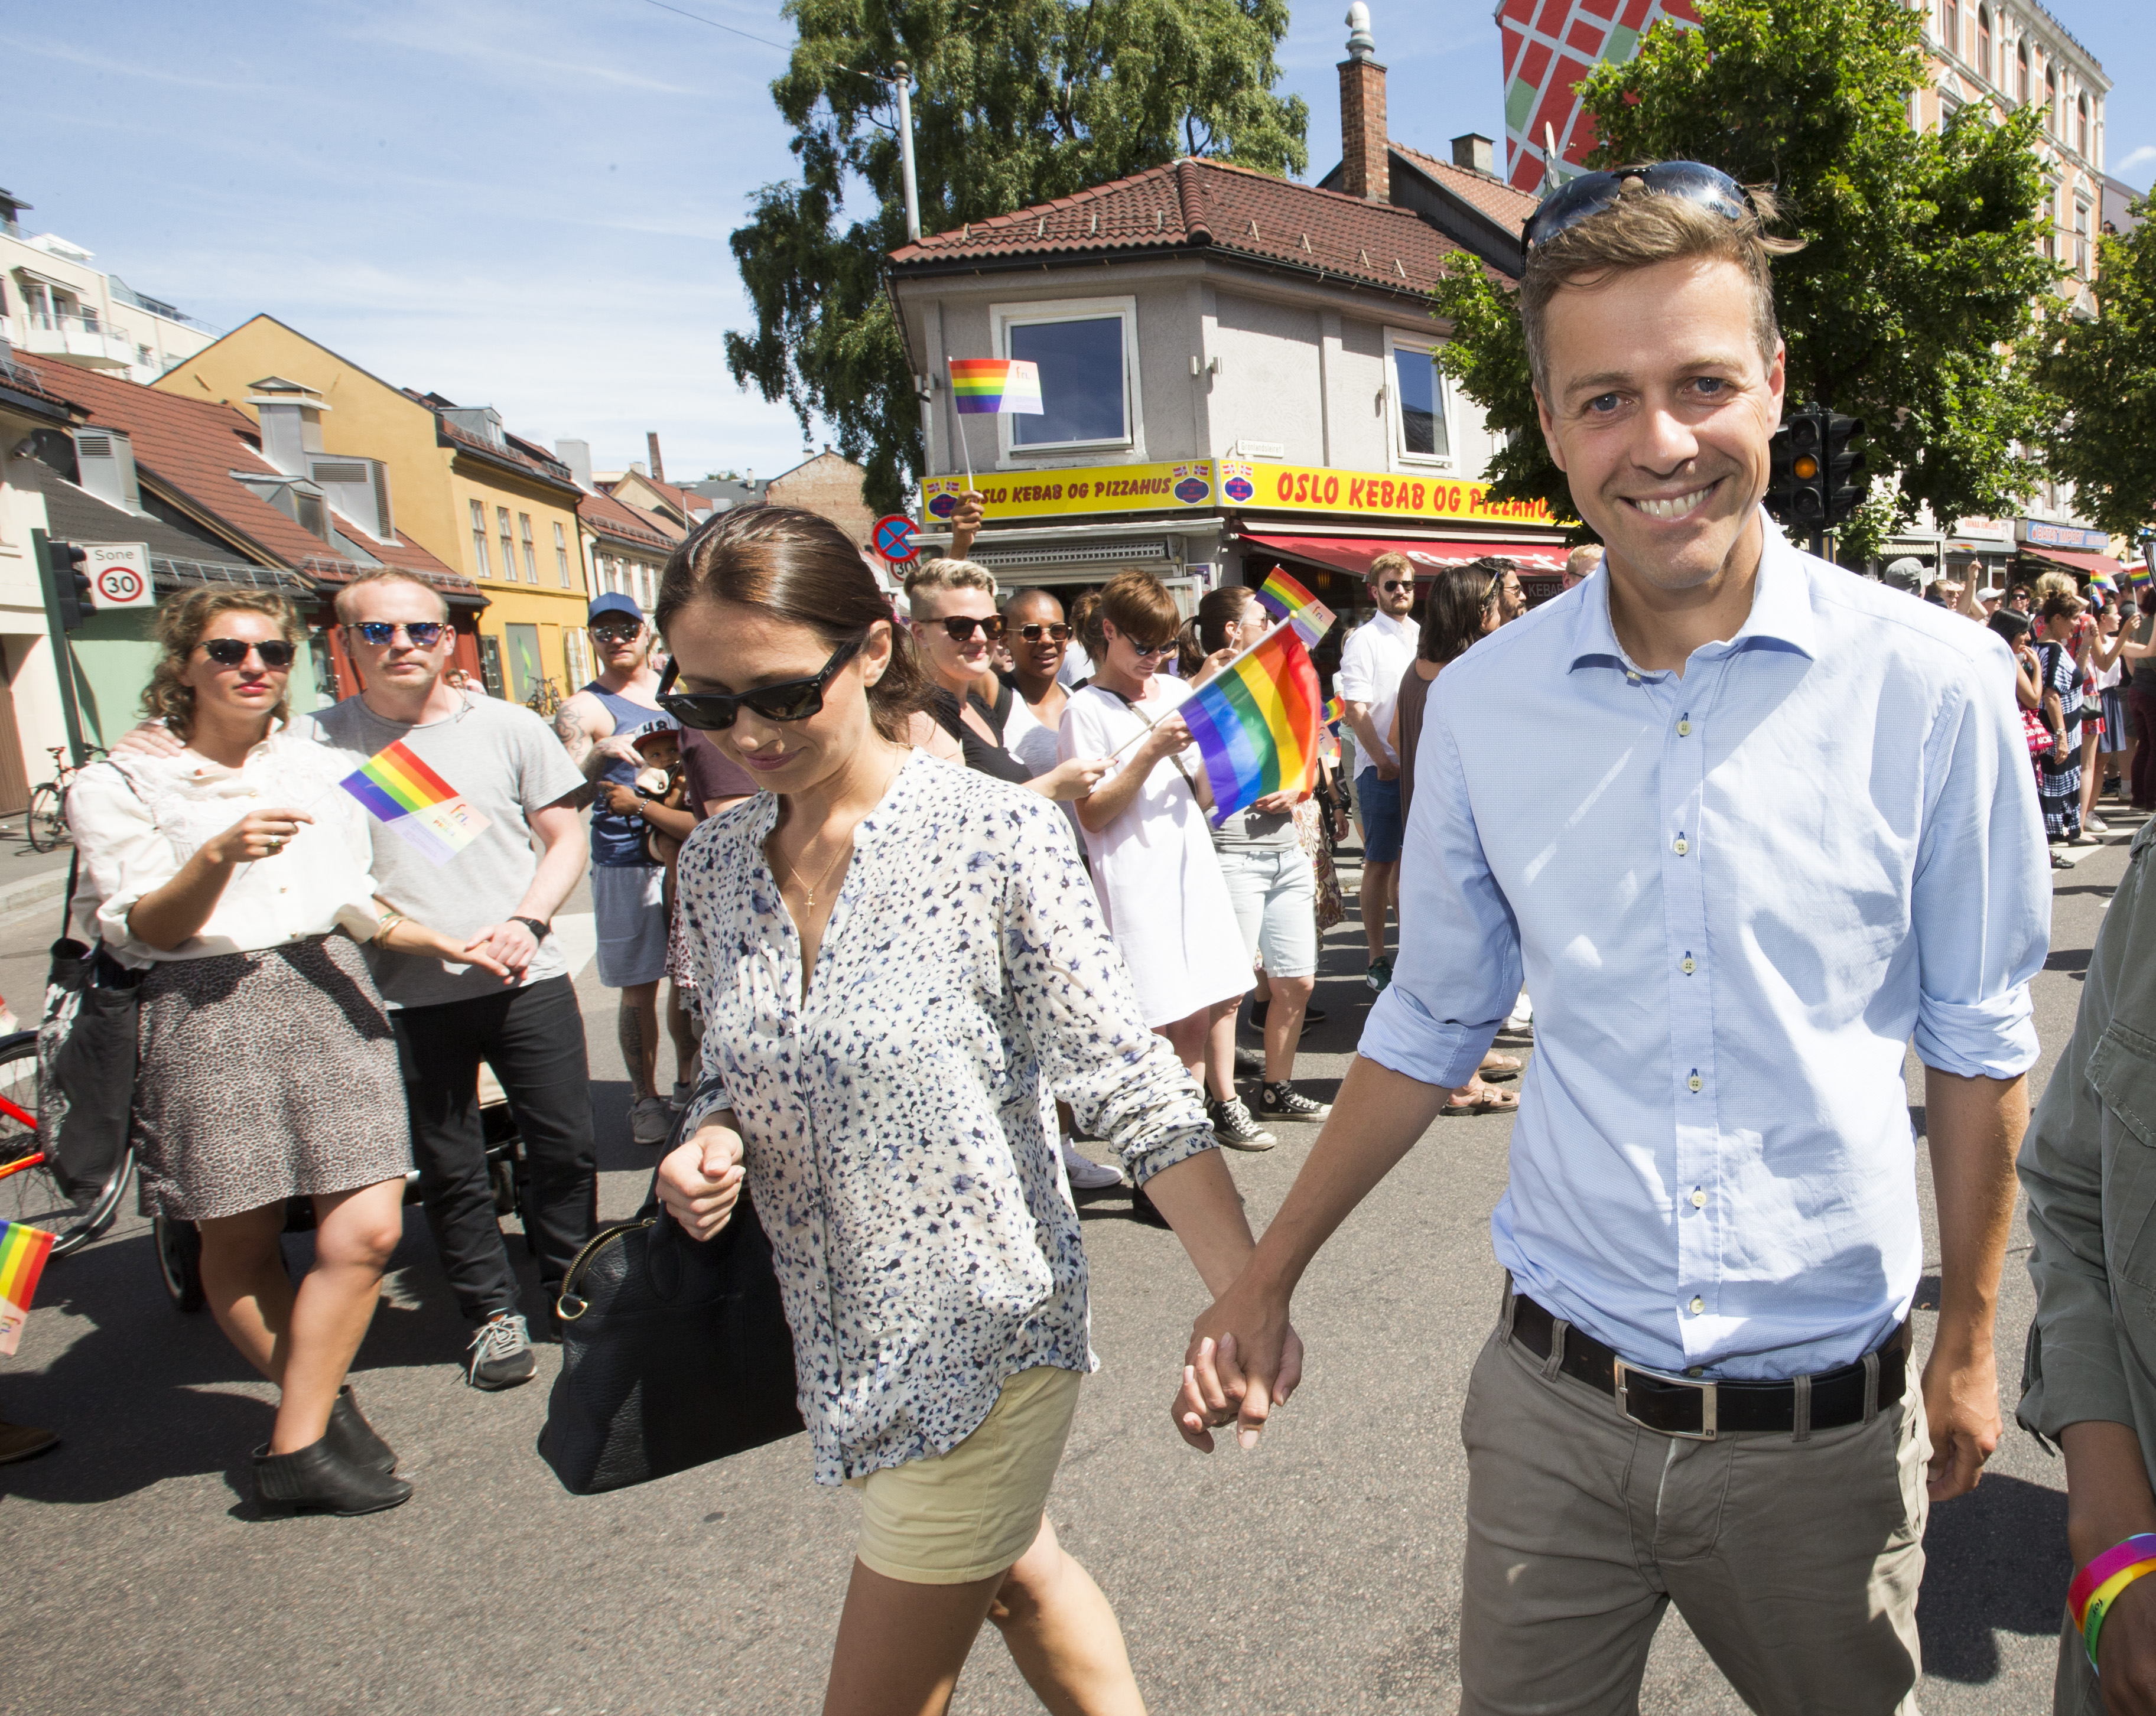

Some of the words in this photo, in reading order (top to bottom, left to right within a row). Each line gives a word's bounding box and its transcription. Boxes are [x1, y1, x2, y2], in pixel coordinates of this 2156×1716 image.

[971, 488, 1007, 504] SLO
[1012, 484, 1063, 503] KEBAB
[1068, 483, 1089, 499] OG
[1094, 477, 1172, 497] PIZZAHUS
[1277, 471, 1339, 505] OSLO
[1348, 477, 1425, 510] KEBAB
[1433, 485, 1461, 513] OG
[1469, 487, 1555, 519] PIZZAHU
[2059, 528, 2085, 545] IMPORT
[95, 549, 135, 561] Sone
[895, 562, 914, 575] 30
[106, 575, 135, 594] 30
[1528, 583, 1565, 597] KEBAB
